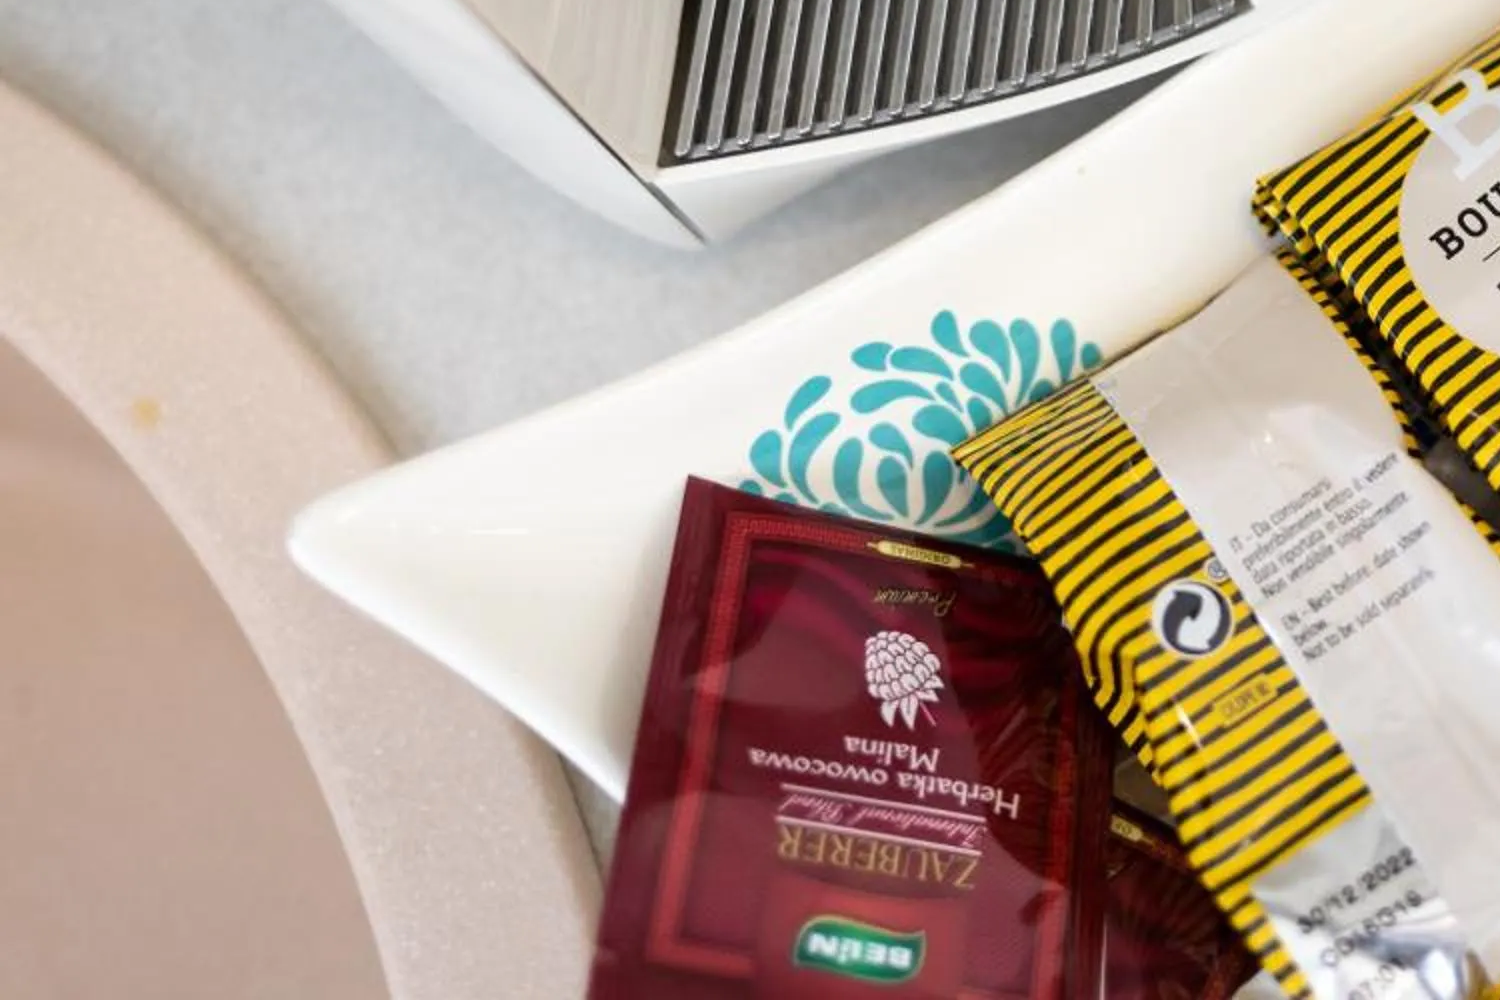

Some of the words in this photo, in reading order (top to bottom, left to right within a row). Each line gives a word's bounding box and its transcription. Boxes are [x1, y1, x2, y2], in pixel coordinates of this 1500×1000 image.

[748, 746, 889, 785] owocowa
[843, 735, 940, 773] Malina
[897, 771, 1021, 820] Herbatka
[777, 826, 980, 889] ZAUBERER
